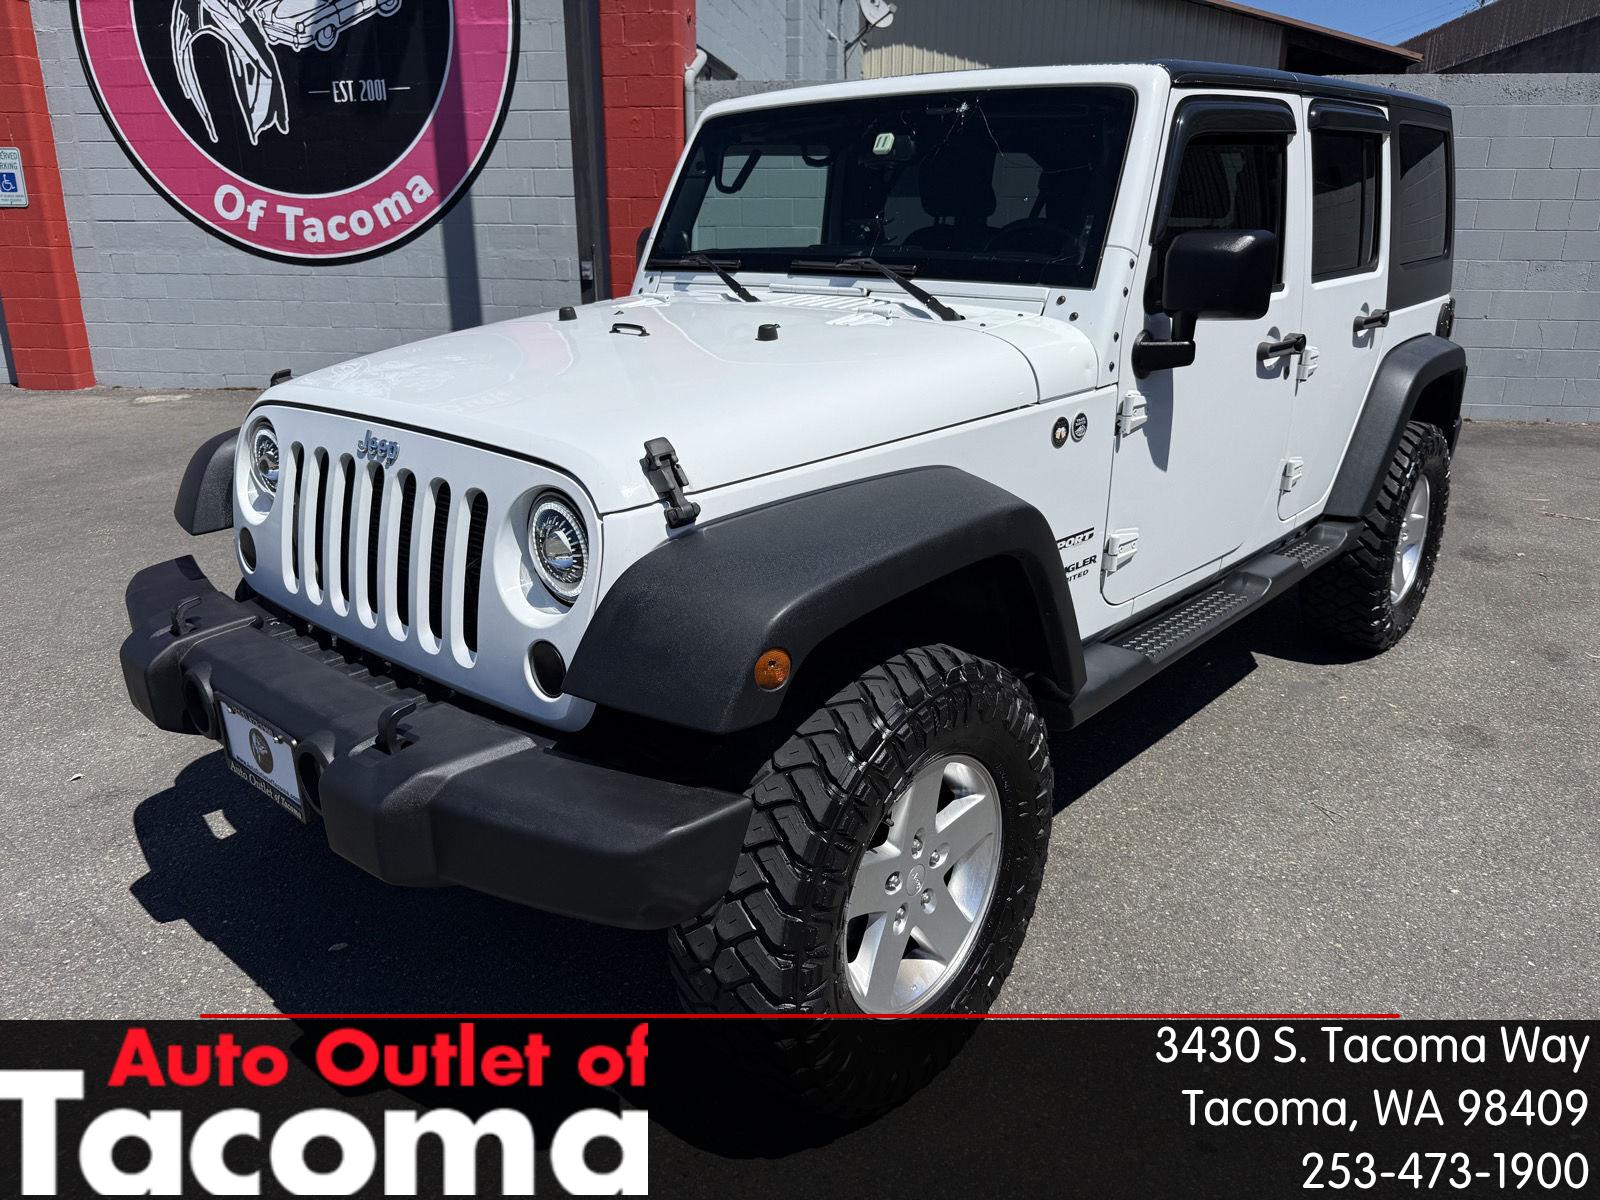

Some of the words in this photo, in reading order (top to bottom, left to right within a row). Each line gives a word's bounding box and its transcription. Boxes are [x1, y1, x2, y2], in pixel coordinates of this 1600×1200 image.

[332, 80, 357, 103] EST.
[359, 79, 387, 102] 2001
[213, 183, 267, 232] Of
[276, 174, 435, 243] Tacoma
[356, 429, 400, 469] Jeep
